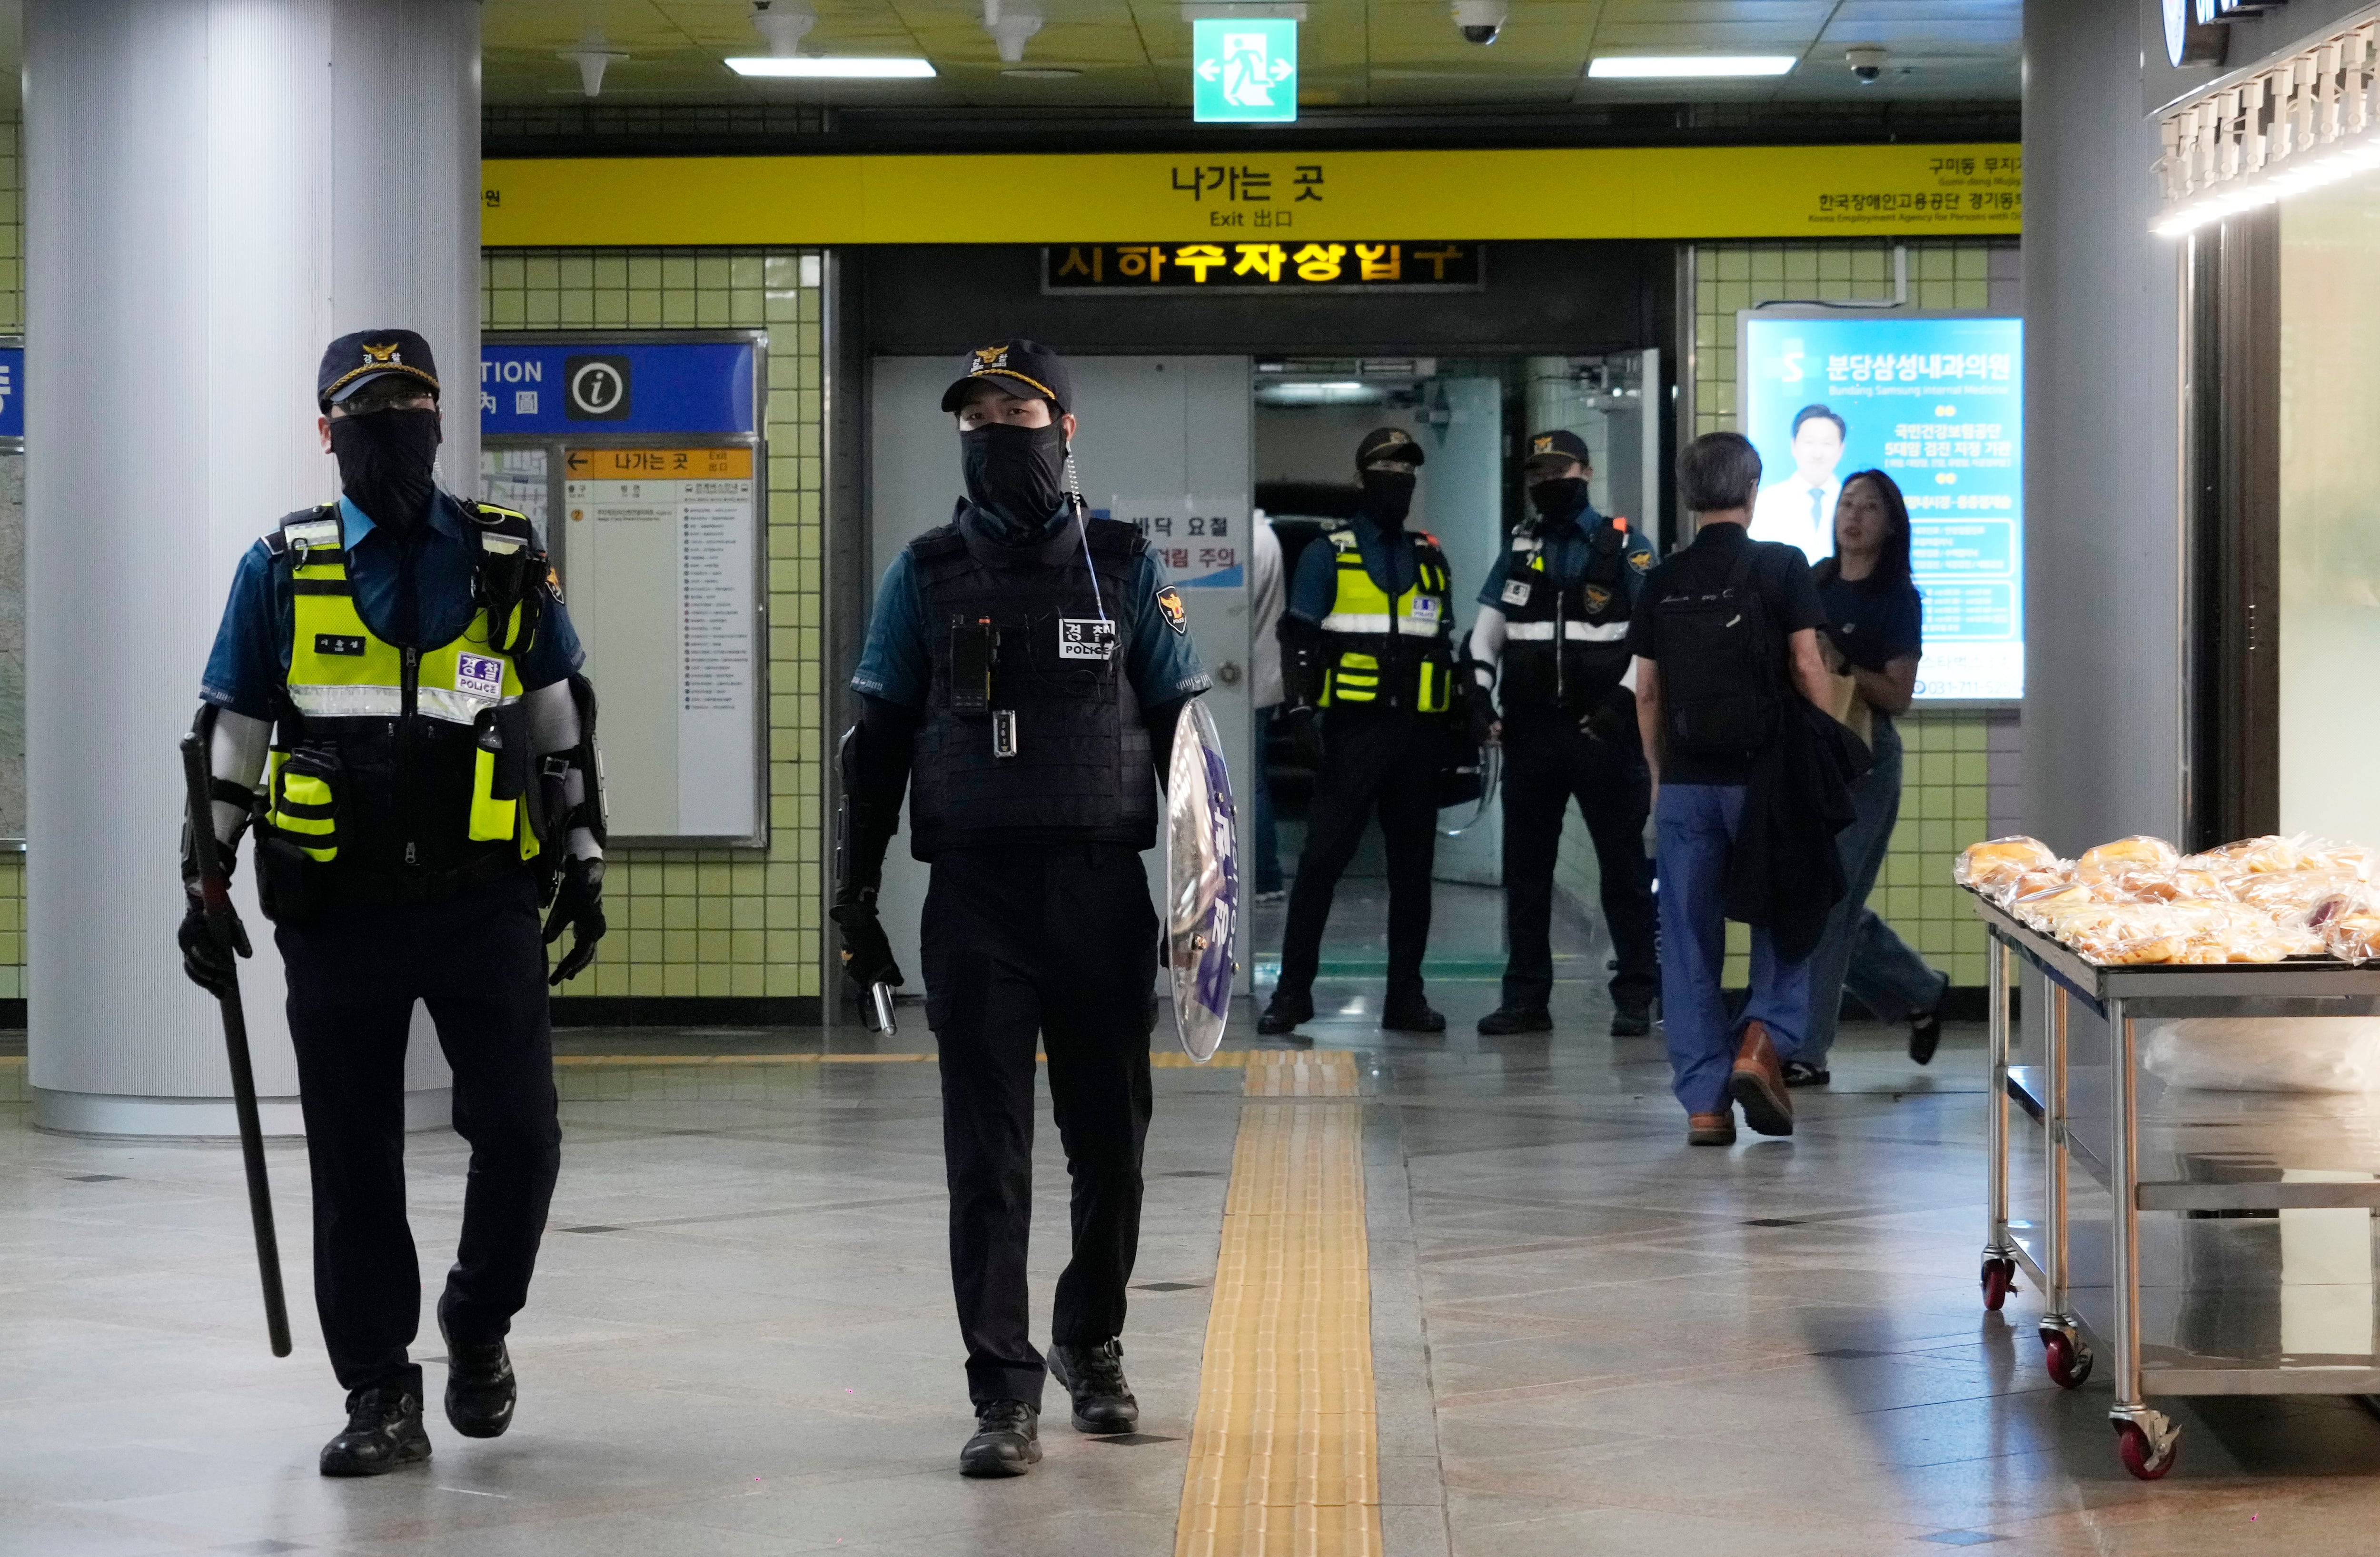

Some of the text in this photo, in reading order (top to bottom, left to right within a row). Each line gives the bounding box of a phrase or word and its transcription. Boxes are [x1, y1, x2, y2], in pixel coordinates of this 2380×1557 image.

[1172, 166, 1324, 201] 나가는 곳
[1210, 210, 1292, 228] Exit 出口
[480, 361, 542, 383] TION
[1827, 353, 2011, 381] 분당삼성내과의원
[615, 453, 688, 470] 나가는 곳
[1199, 548, 1234, 567] 주의
[461, 679, 496, 694] POLICE
